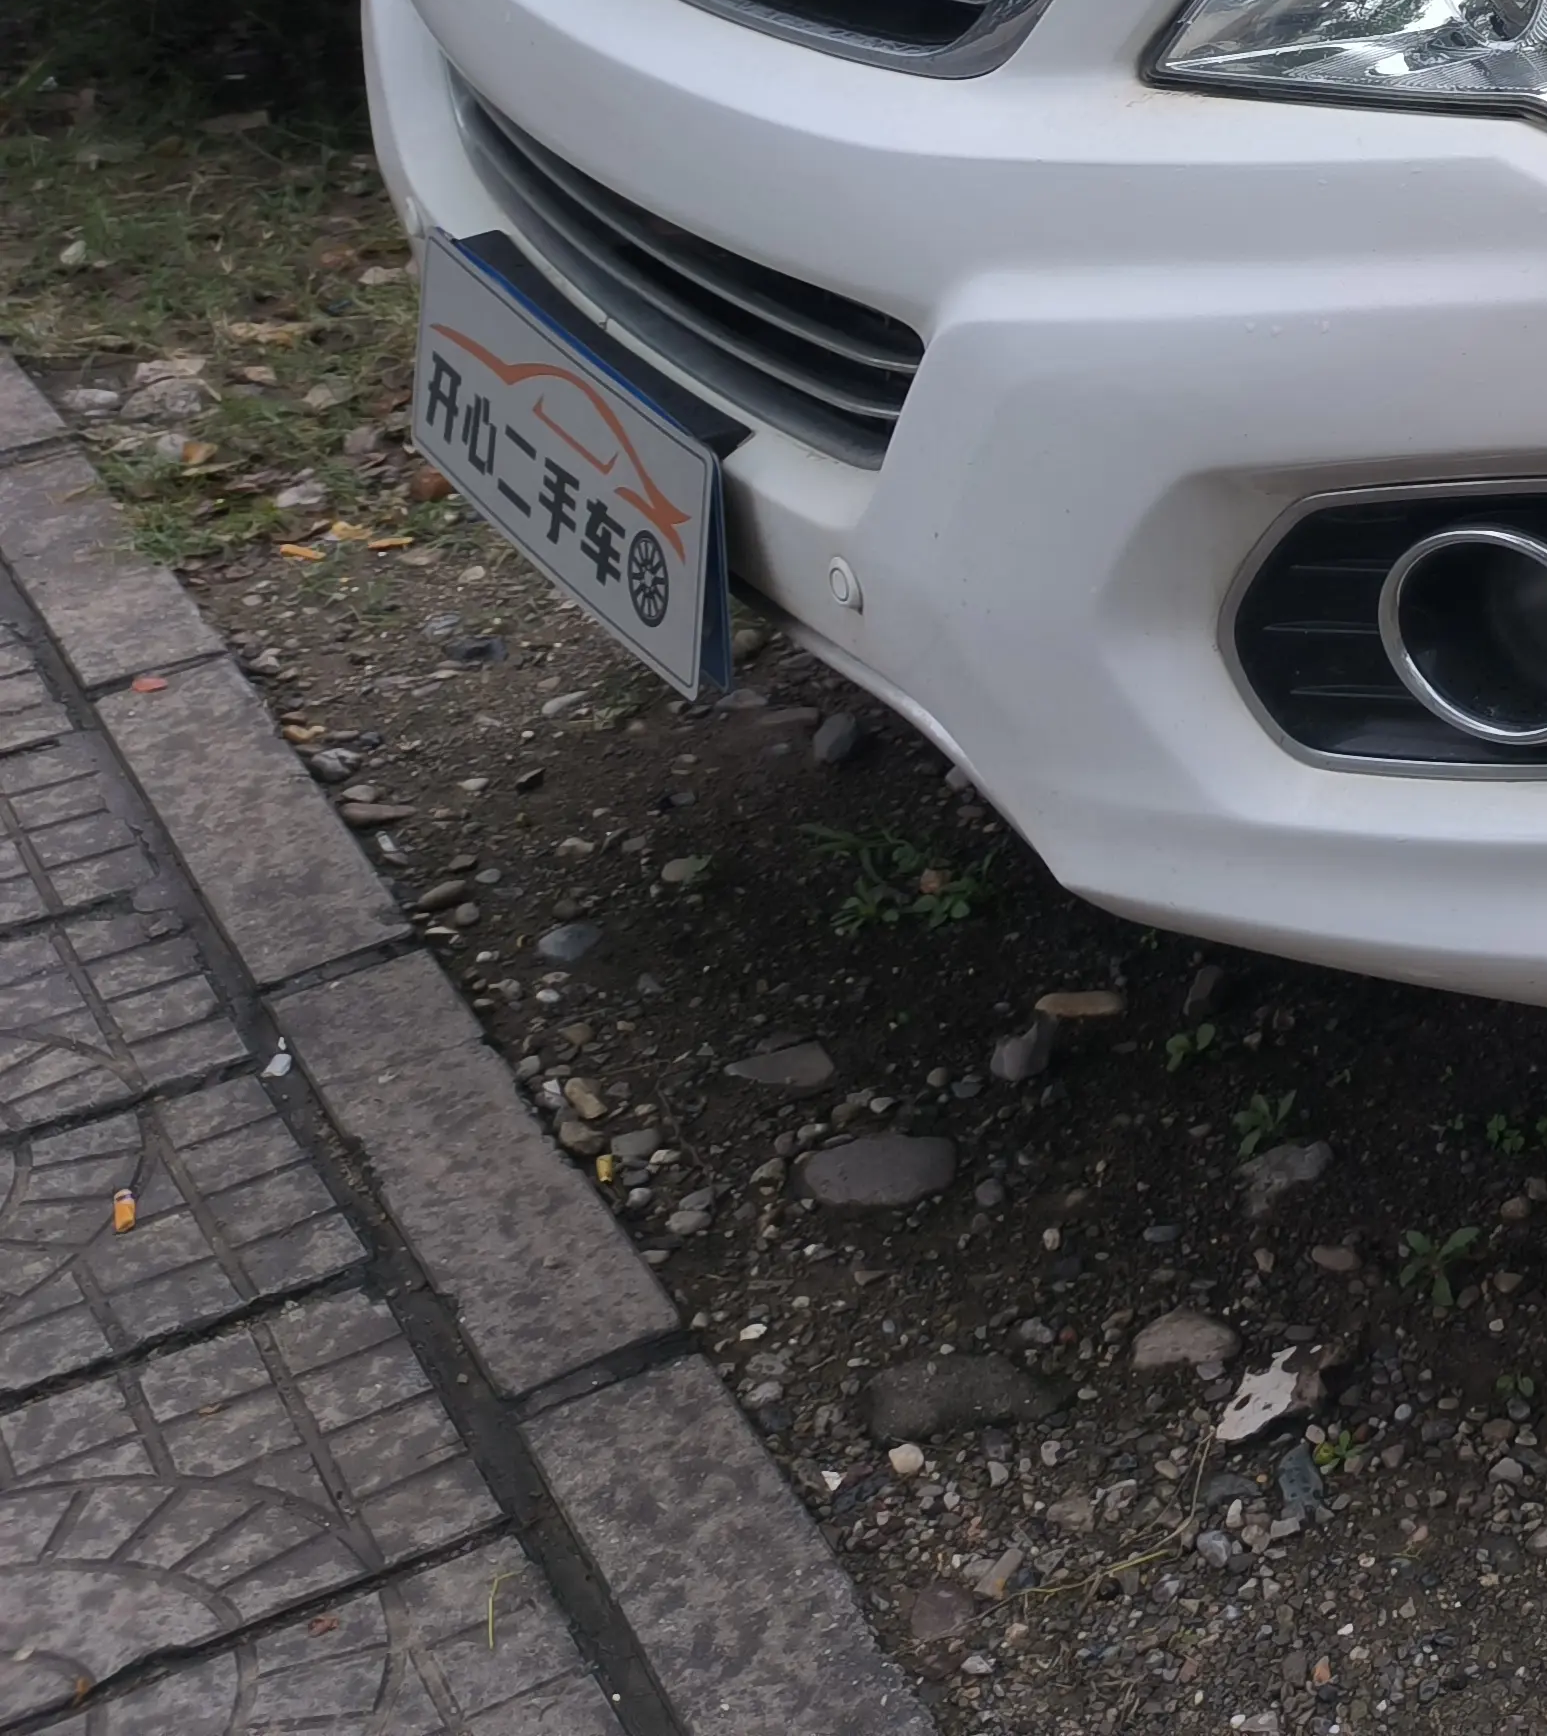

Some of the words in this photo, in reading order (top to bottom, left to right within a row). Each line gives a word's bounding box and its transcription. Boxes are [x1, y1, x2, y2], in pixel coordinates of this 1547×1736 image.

[425, 349, 626, 587] 开心二手车
